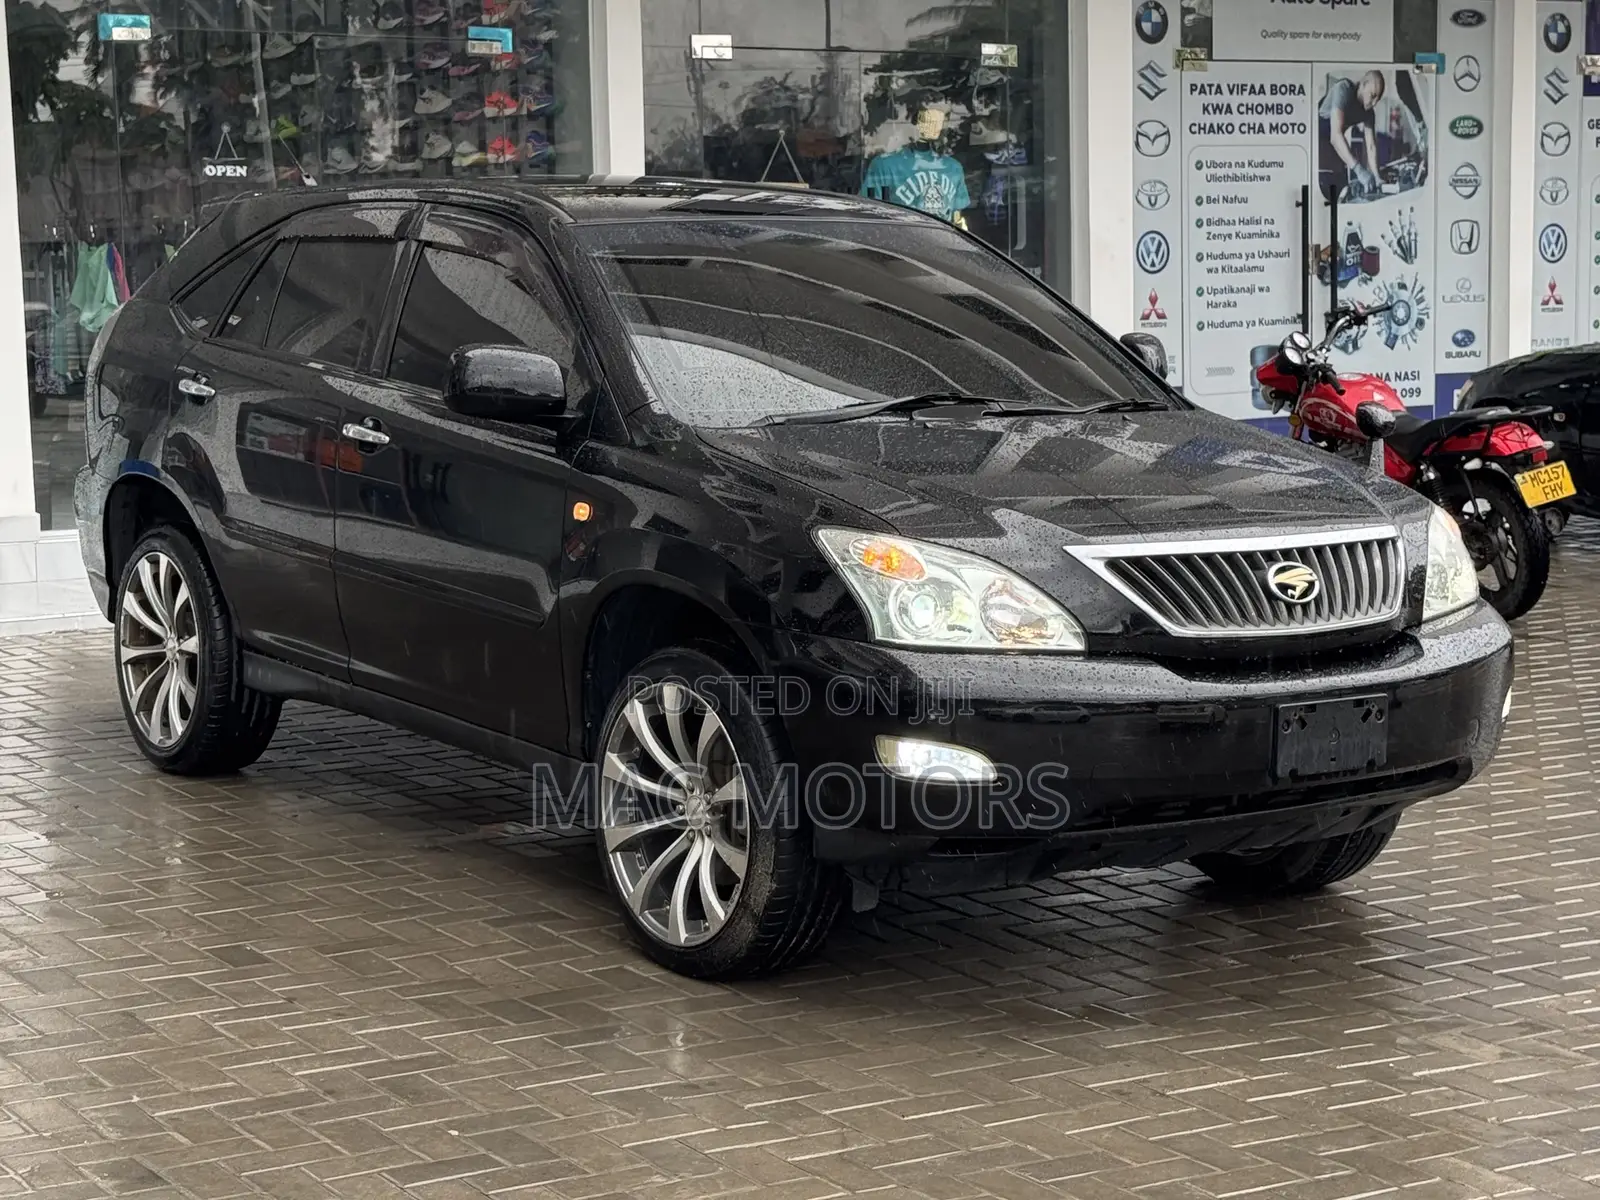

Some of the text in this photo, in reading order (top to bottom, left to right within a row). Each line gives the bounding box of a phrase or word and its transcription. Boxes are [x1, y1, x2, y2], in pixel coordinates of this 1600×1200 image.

[1260, 29, 1361, 42] Quality spare for everybody
[1189, 83, 1306, 96] PATA VIFAA BORA
[1202, 103, 1294, 116] KWA CHOMBO
[1188, 122, 1307, 135] CHAKO CHA MOTO
[1205, 159, 1284, 169] Ubora na Kudumu
[205, 164, 248, 178] OPEN
[1206, 194, 1248, 205] Bei Nafuu
[1206, 216, 1275, 227] Bidhaa Halisi na
[1206, 229, 1281, 242] Zenye Kuaminika
[1206, 249, 1291, 261] Huduma ya Ushauri
[1206, 264, 1265, 274] wa Kitaalamu
[1206, 283, 1271, 296] Upatikanaji wa
[1206, 300, 1238, 309] Haraka
[1441, 294, 1486, 304] LEXUS
[1206, 319, 1244, 330] Huduma
[1245, 320, 1256, 329] ya
[1444, 350, 1482, 359] SUBARU
[1394, 370, 1420, 382] NASI
[1400, 387, 1422, 398] 099
[1528, 464, 1565, 488] MC157
